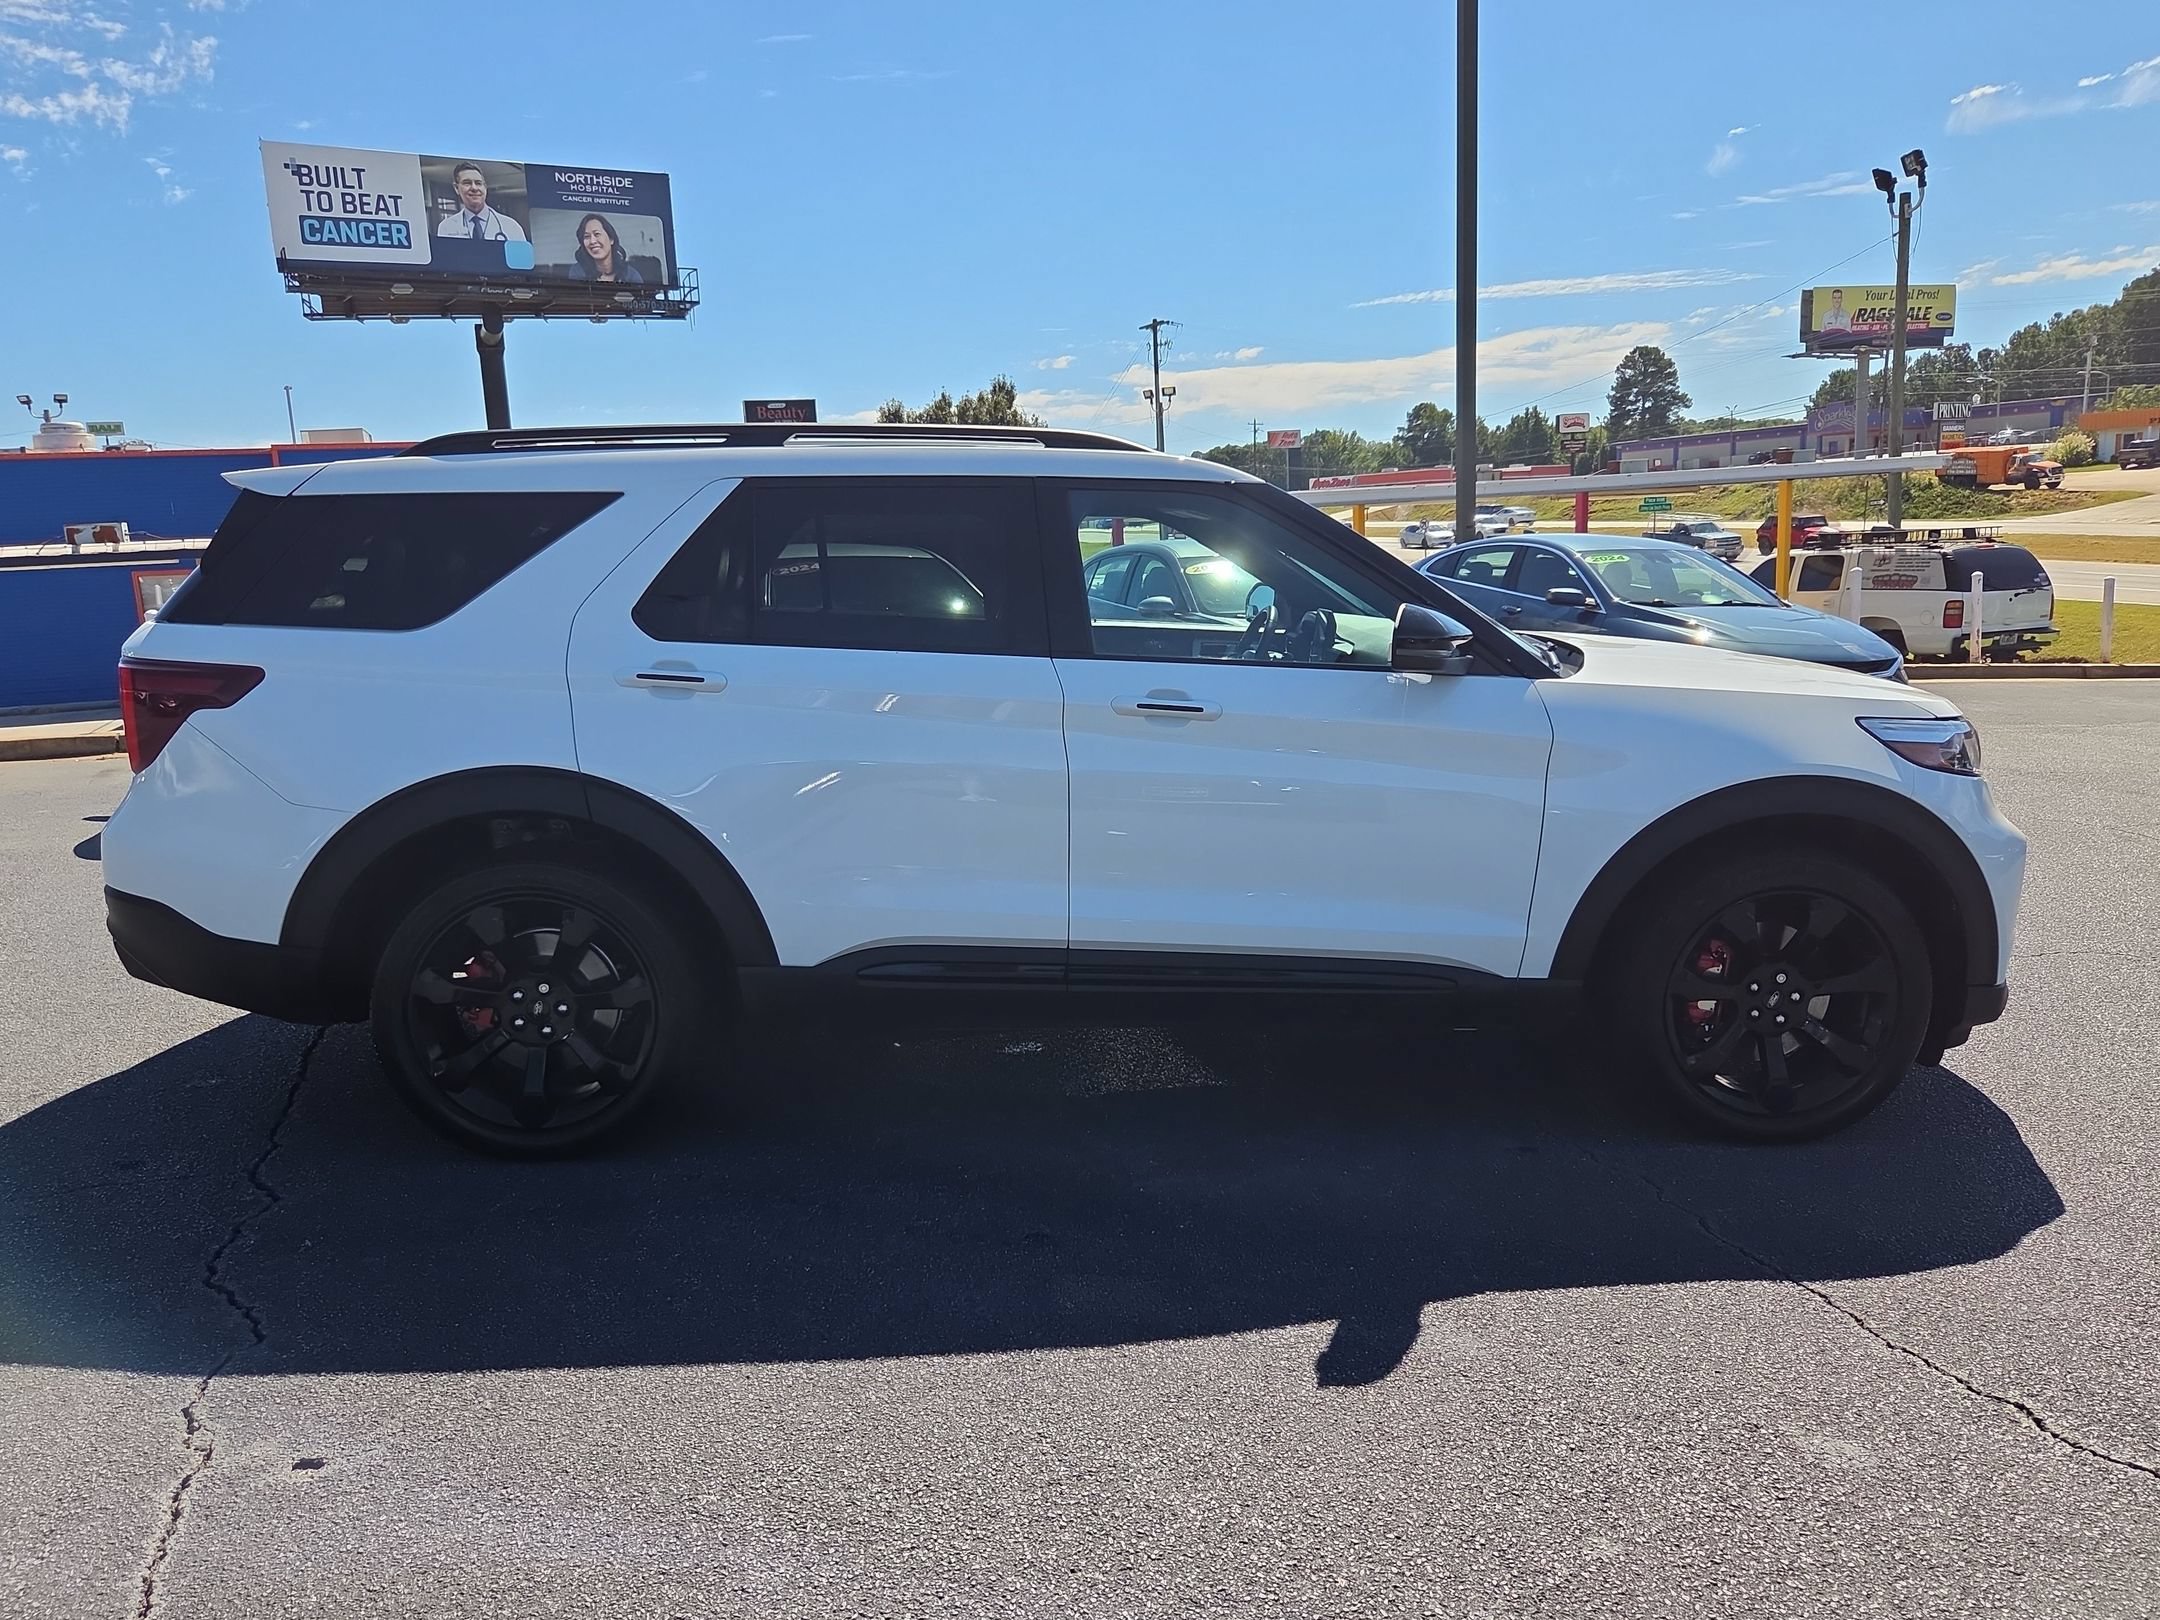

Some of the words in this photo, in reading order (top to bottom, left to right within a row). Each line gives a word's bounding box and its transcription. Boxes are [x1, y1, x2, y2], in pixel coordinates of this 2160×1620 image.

[296, 163, 366, 190] BUILT
[554, 172, 634, 188] NORTHSIDE
[570, 184, 620, 194] HOSPITAL
[300, 189, 333, 213] TO
[340, 191, 403, 216] BEAT
[562, 195, 592, 203] CANCER
[594, 198, 630, 206] INSTITUTE
[302, 219, 409, 246] CANCER
[1865, 289, 1888, 301] Your
[1916, 289, 1940, 300] Pros!
[1855, 306, 1933, 322] RAGSALE
[756, 406, 805, 421] Beauty
[1939, 403, 1970, 418] PRINTING
[1591, 555, 1625, 563] 2024
[779, 563, 820, 574] 2024
